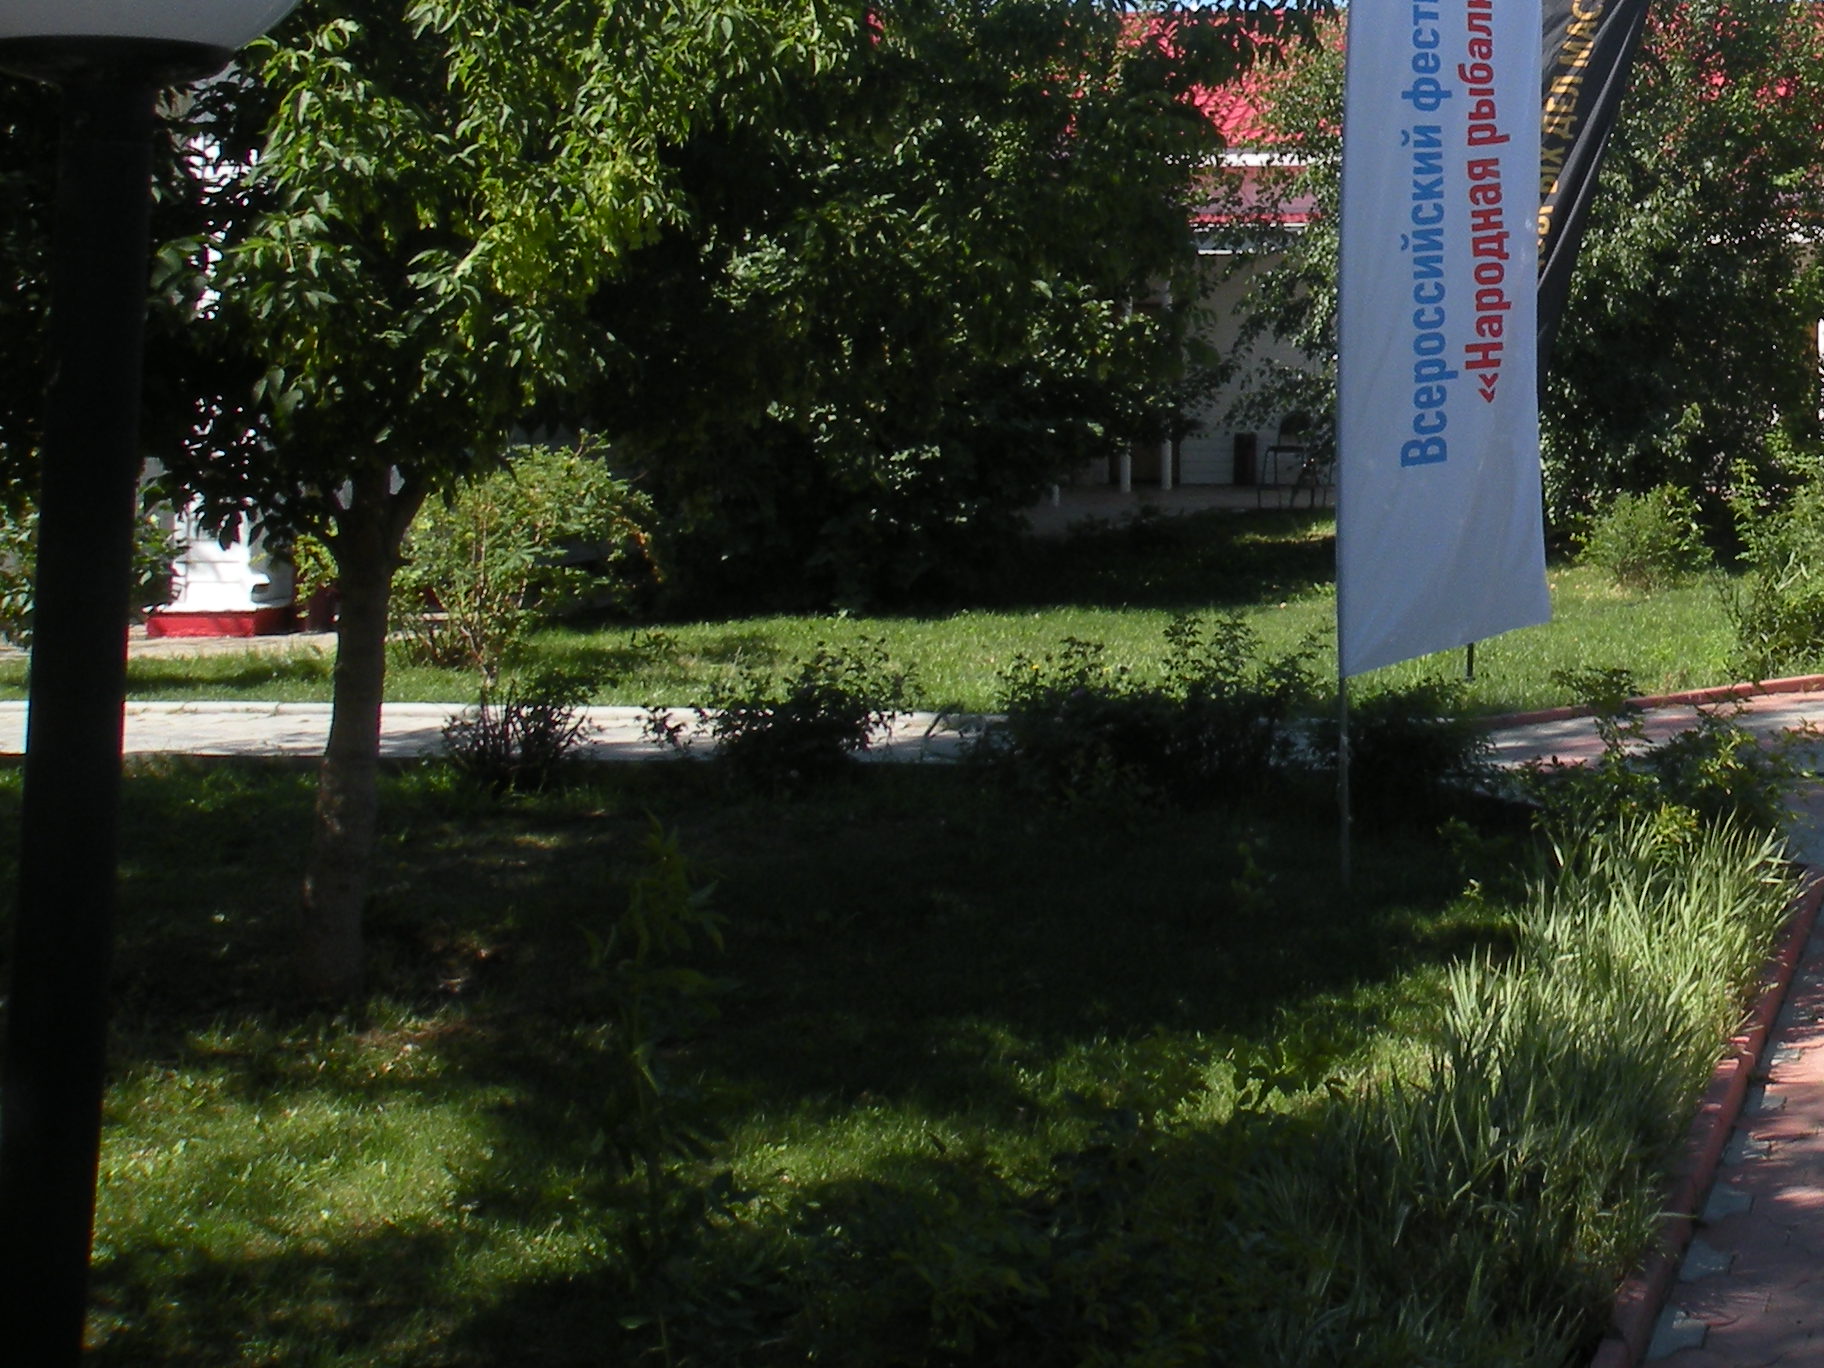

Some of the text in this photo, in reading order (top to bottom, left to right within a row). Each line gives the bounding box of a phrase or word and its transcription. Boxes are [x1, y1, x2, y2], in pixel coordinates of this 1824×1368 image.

[1540, 76, 1584, 141] ДЕЛ
[1400, 124, 1458, 468] Всероссийский
[1464, 157, 1512, 404] «Народная
